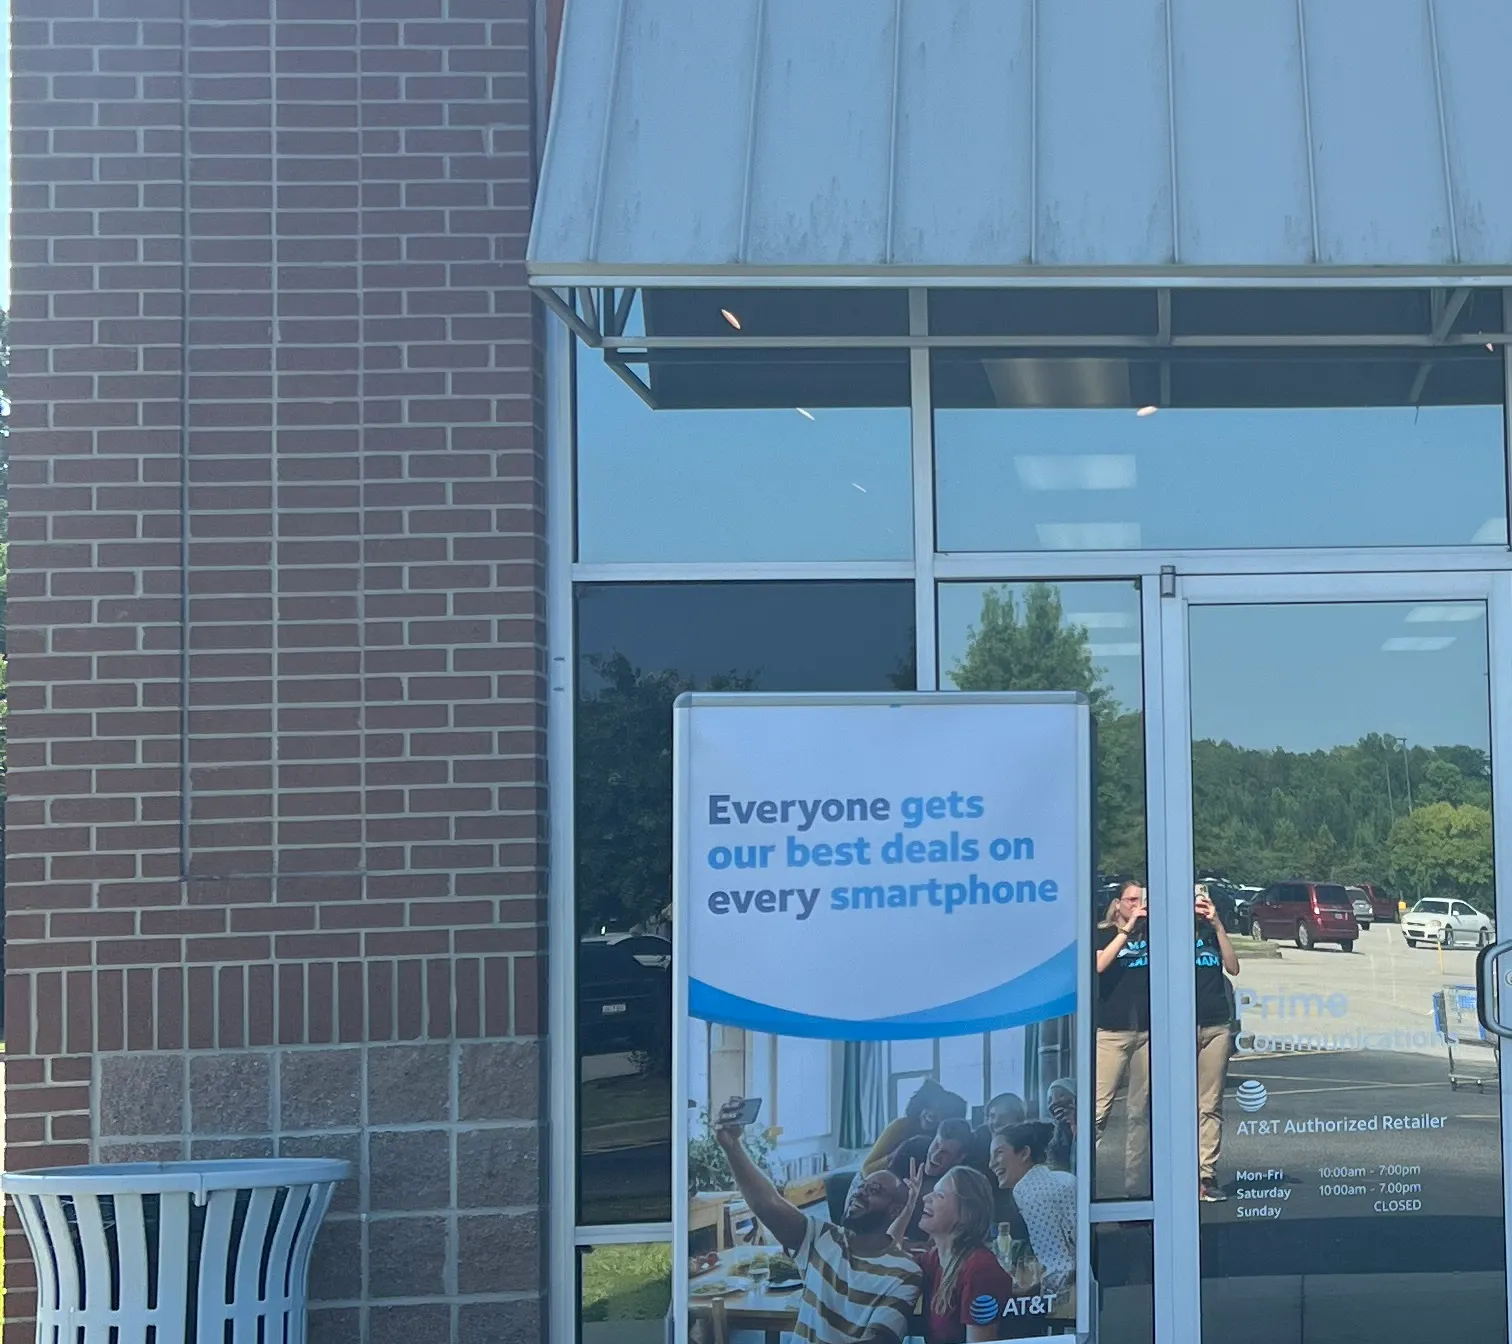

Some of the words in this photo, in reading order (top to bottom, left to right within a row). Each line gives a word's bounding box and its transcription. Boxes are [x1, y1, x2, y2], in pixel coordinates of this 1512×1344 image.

[708, 794, 891, 831] Everyone
[901, 790, 984, 828] gets
[708, 844, 776, 870] our
[786, 835, 871, 868] best
[880, 831, 980, 865] deals
[989, 835, 1035, 863] on
[708, 887, 821, 921] every
[830, 874, 1058, 914] smartphone
[1235, 986, 1350, 1020] Prime
[1235, 1028, 1460, 1052] Communications
[1236, 1120, 1280, 1136] AT&T
[1284, 1116, 1378, 1134] Authorized
[1382, 1113, 1448, 1130] Retailer
[1236, 1169, 1284, 1181] Mon-Fri
[1319, 1166, 1366, 1178] 10:00am
[1379, 1165, 1421, 1177] 7:00pm
[1236, 1187, 1291, 1201] Saturday
[1319, 1184, 1367, 1196] 10:00am
[1379, 1182, 1422, 1195] 7:00pm
[1236, 1205, 1282, 1220] Sunday
[1373, 1199, 1422, 1213] CLOSED
[1002, 1293, 1057, 1317] AT&T
